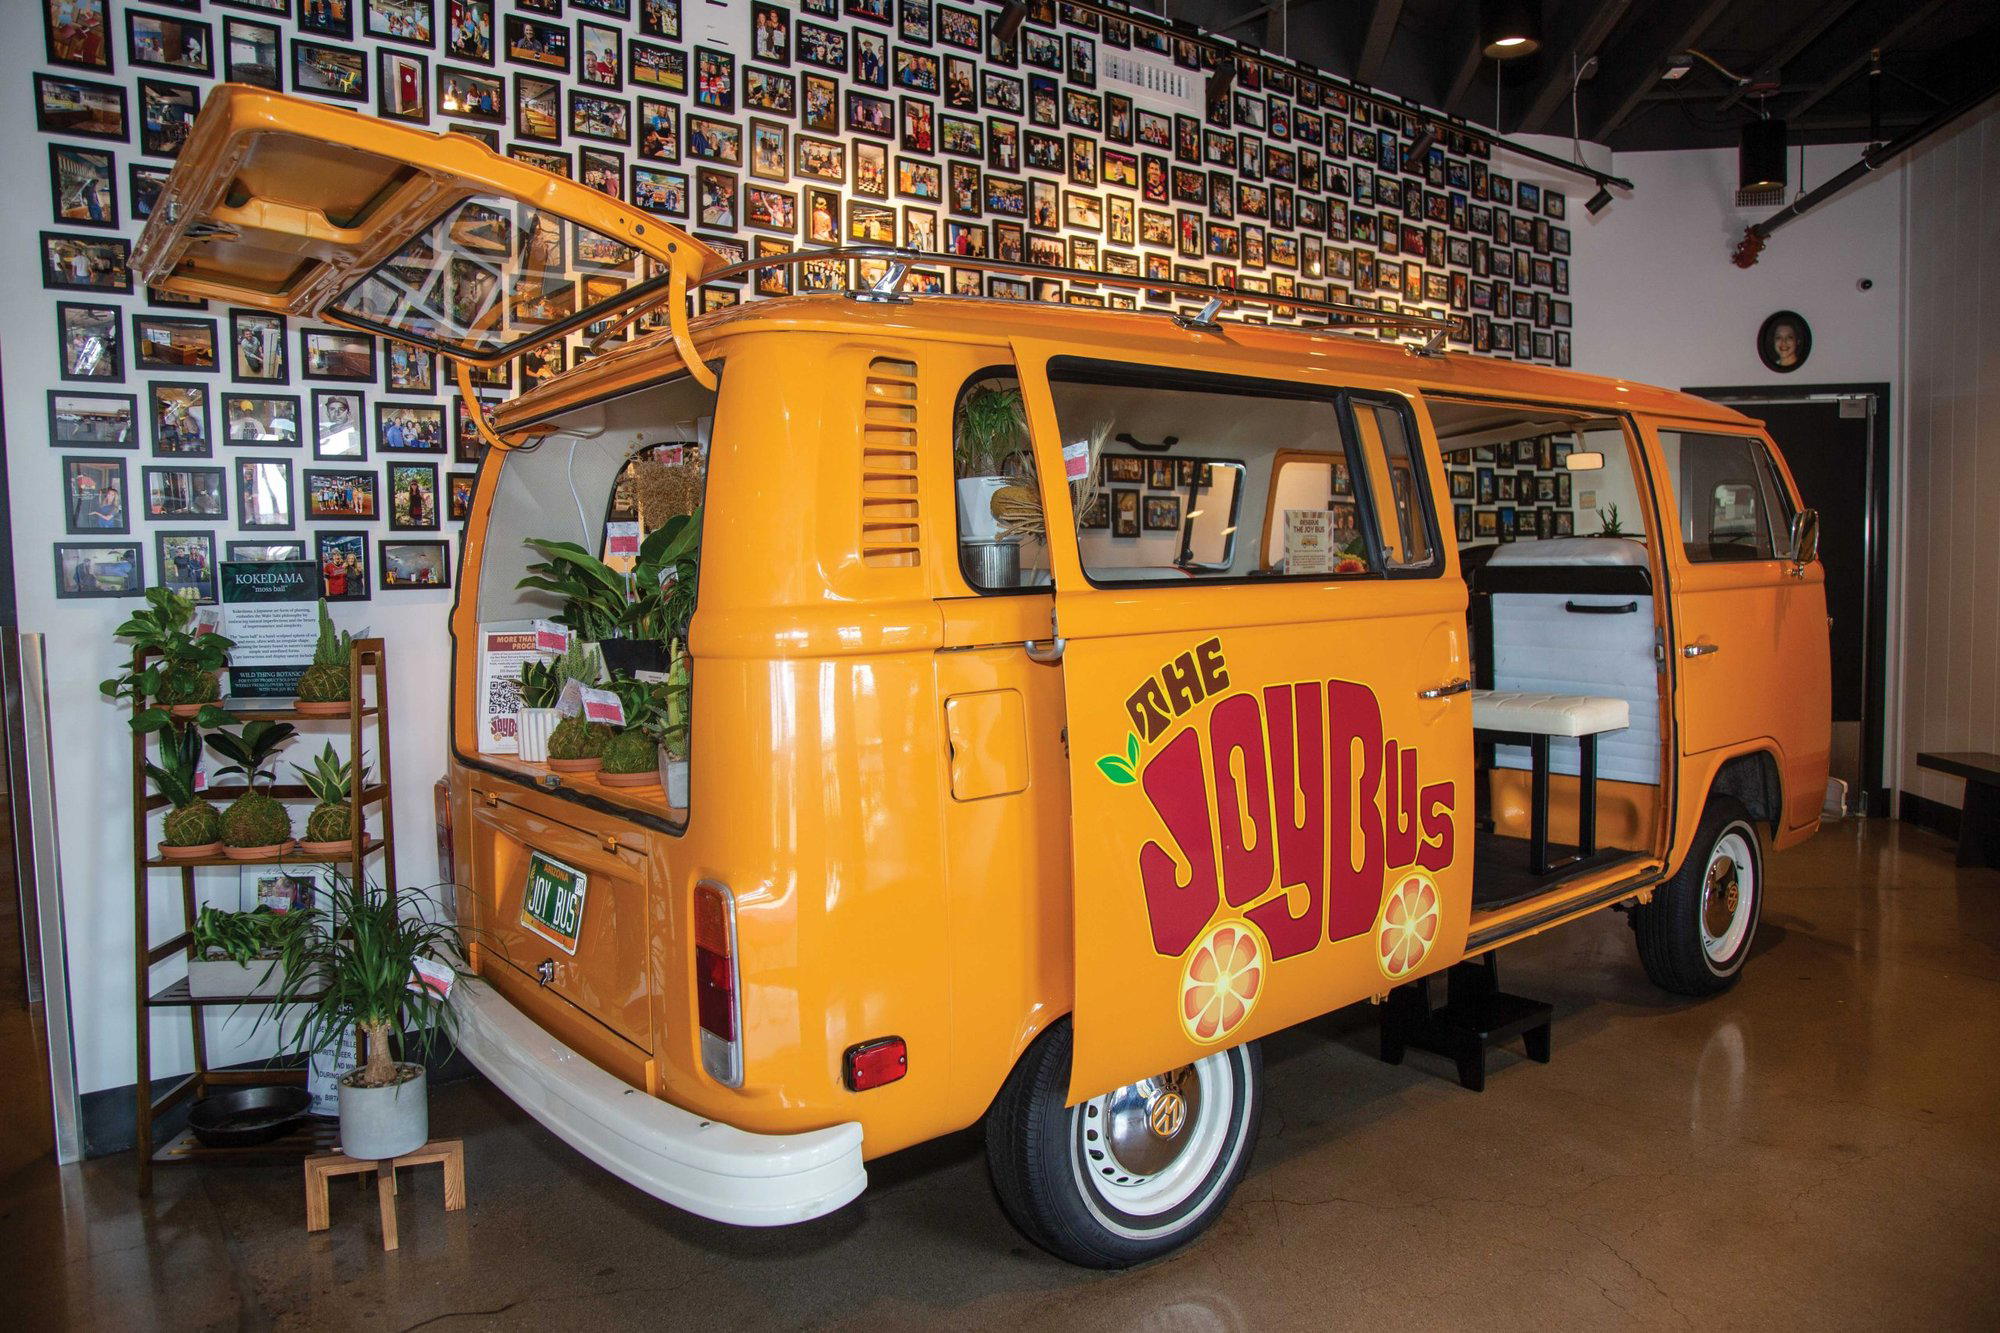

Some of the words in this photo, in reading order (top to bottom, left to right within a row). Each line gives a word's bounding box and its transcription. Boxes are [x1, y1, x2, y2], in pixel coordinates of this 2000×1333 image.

[235, 574, 304, 584] KOKEDAMA
[1126, 636, 1230, 744] THE
[544, 864, 569, 883] ARIZONA
[528, 876, 552, 918] JOY
[552, 886, 577, 933] BUS
